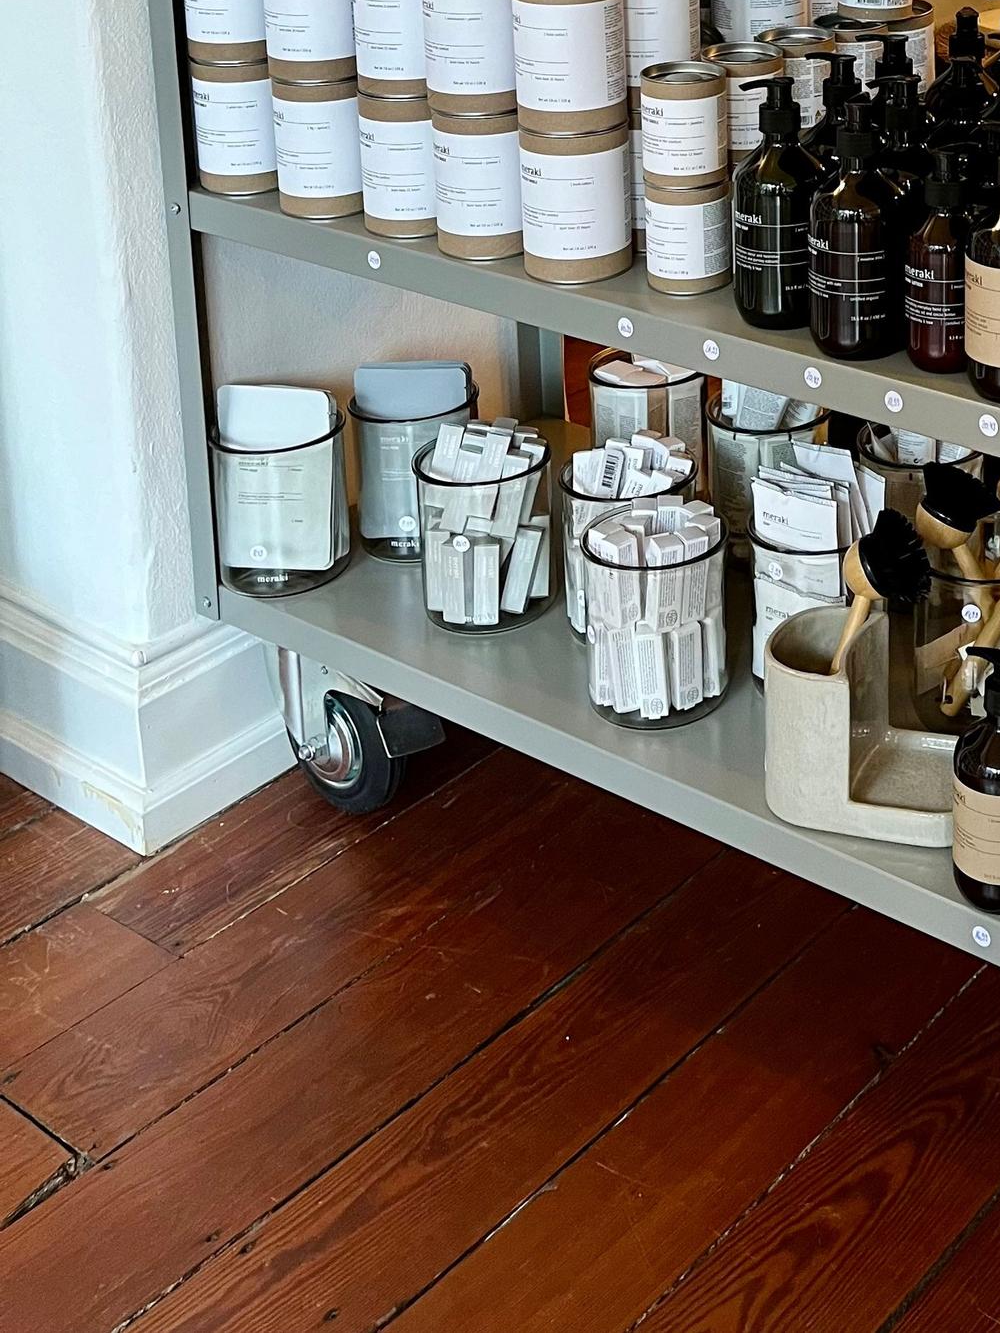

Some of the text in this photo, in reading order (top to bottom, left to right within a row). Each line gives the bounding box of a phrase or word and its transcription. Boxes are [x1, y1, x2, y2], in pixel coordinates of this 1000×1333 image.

[735, 211, 762, 224] meraki
[905, 264, 934, 280] meraki
[762, 510, 789, 526] meraki
[257, 573, 289, 583] meraki
[765, 606, 791, 619] mera
